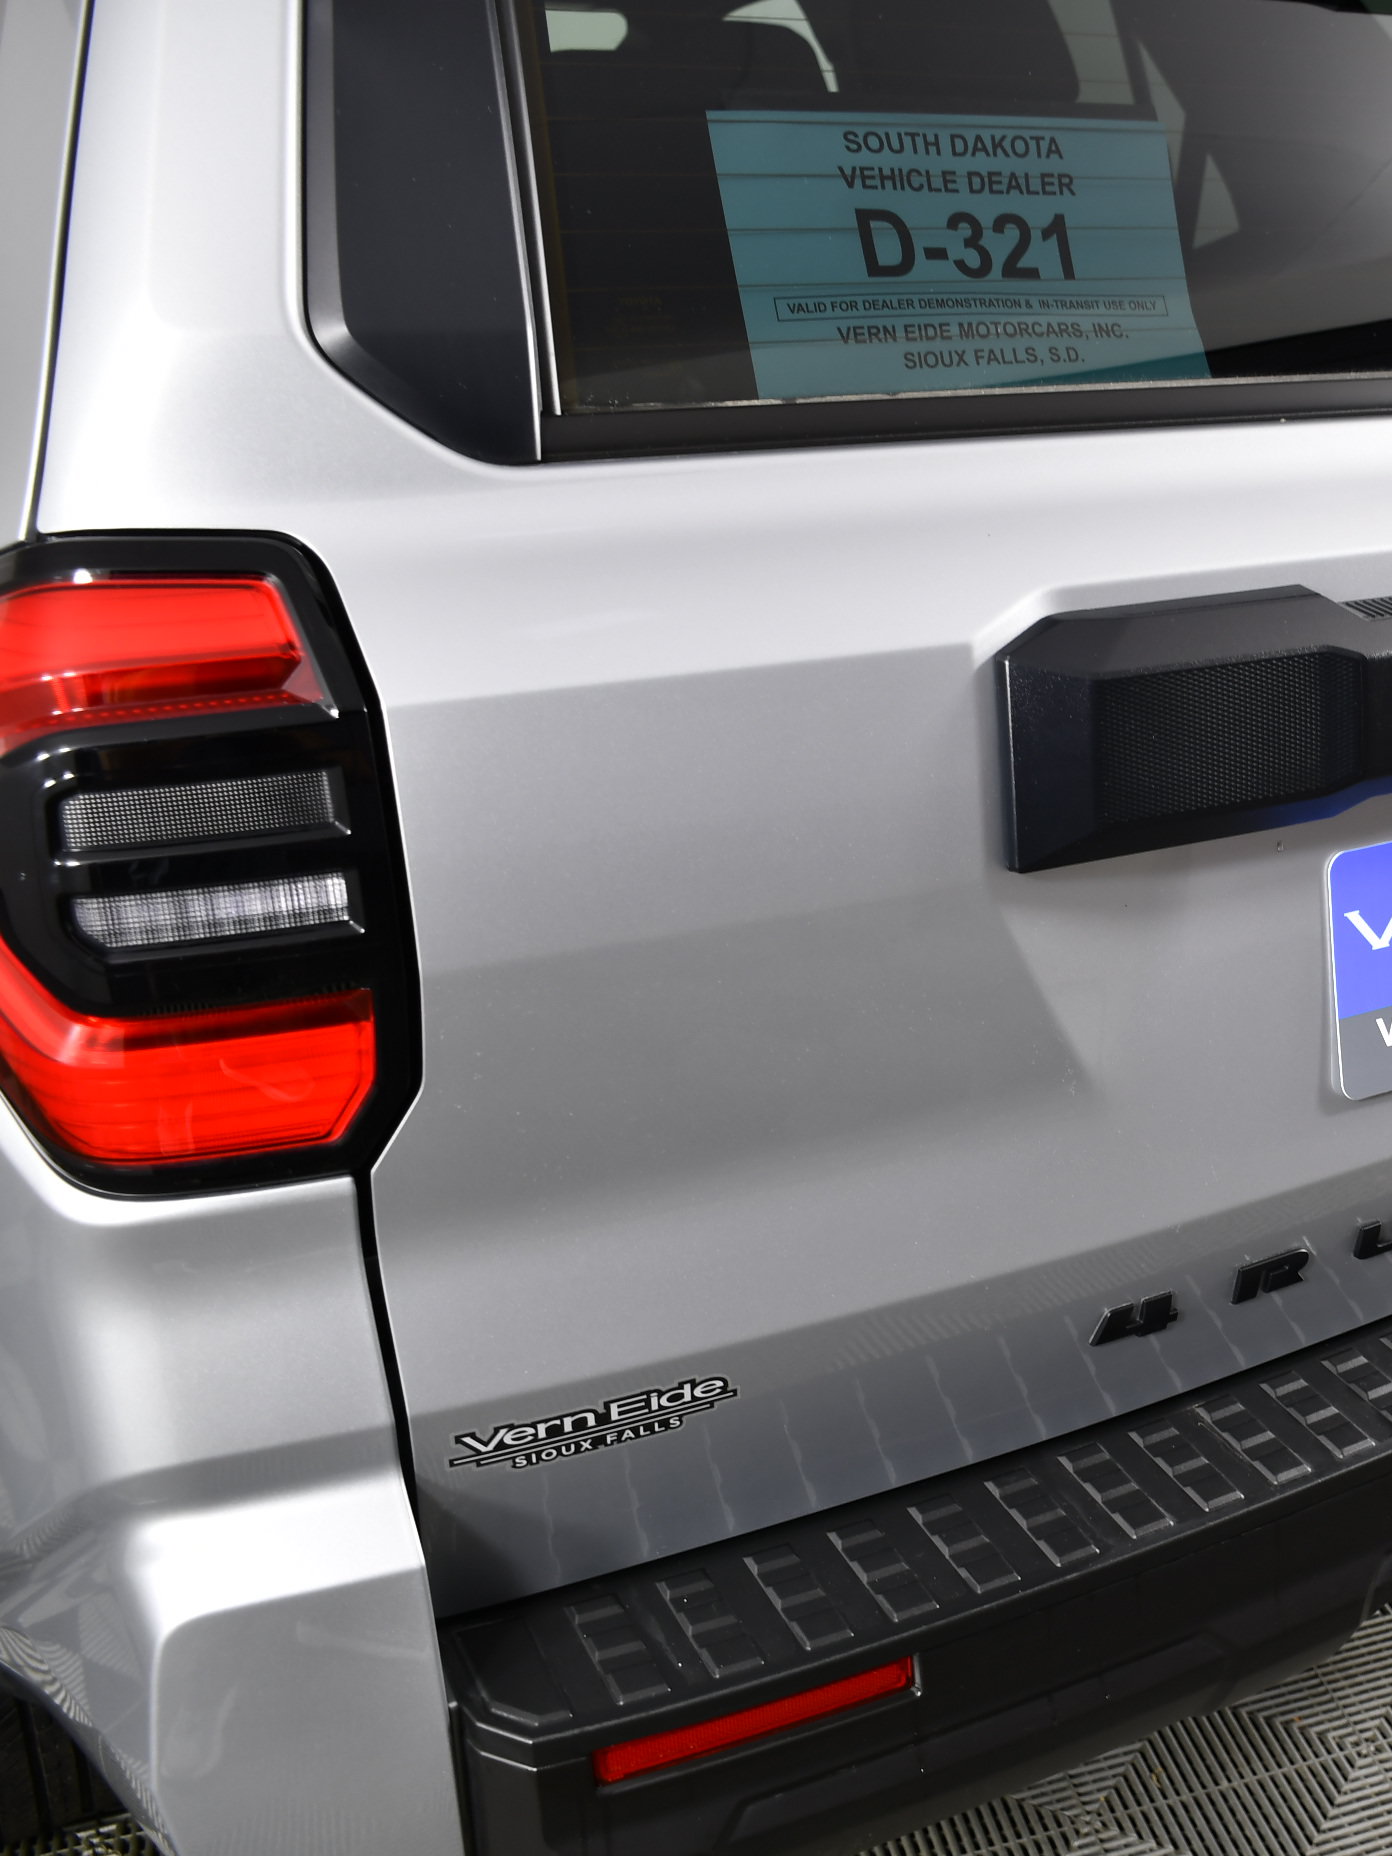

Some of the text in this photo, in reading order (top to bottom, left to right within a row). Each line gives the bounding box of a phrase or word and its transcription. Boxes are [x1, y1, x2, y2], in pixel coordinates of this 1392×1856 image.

[843, 131, 1064, 160] SOUTH DAKOTA
[837, 166, 1077, 197] VEHICLE DEALER
[855, 208, 1076, 280] D-321
[787, 298, 1157, 315] VALID FOR DEALER DEMONSTRATION & IN-TRANSIT USE ONLY
[837, 321, 1129, 344] VERN EIDE MOTORCARS, INC.
[904, 346, 1085, 370] SIOUX FALLS, S.D.
[459, 1378, 727, 1453] Vern Eide
[514, 1415, 683, 1468] SIOUX FALLS
